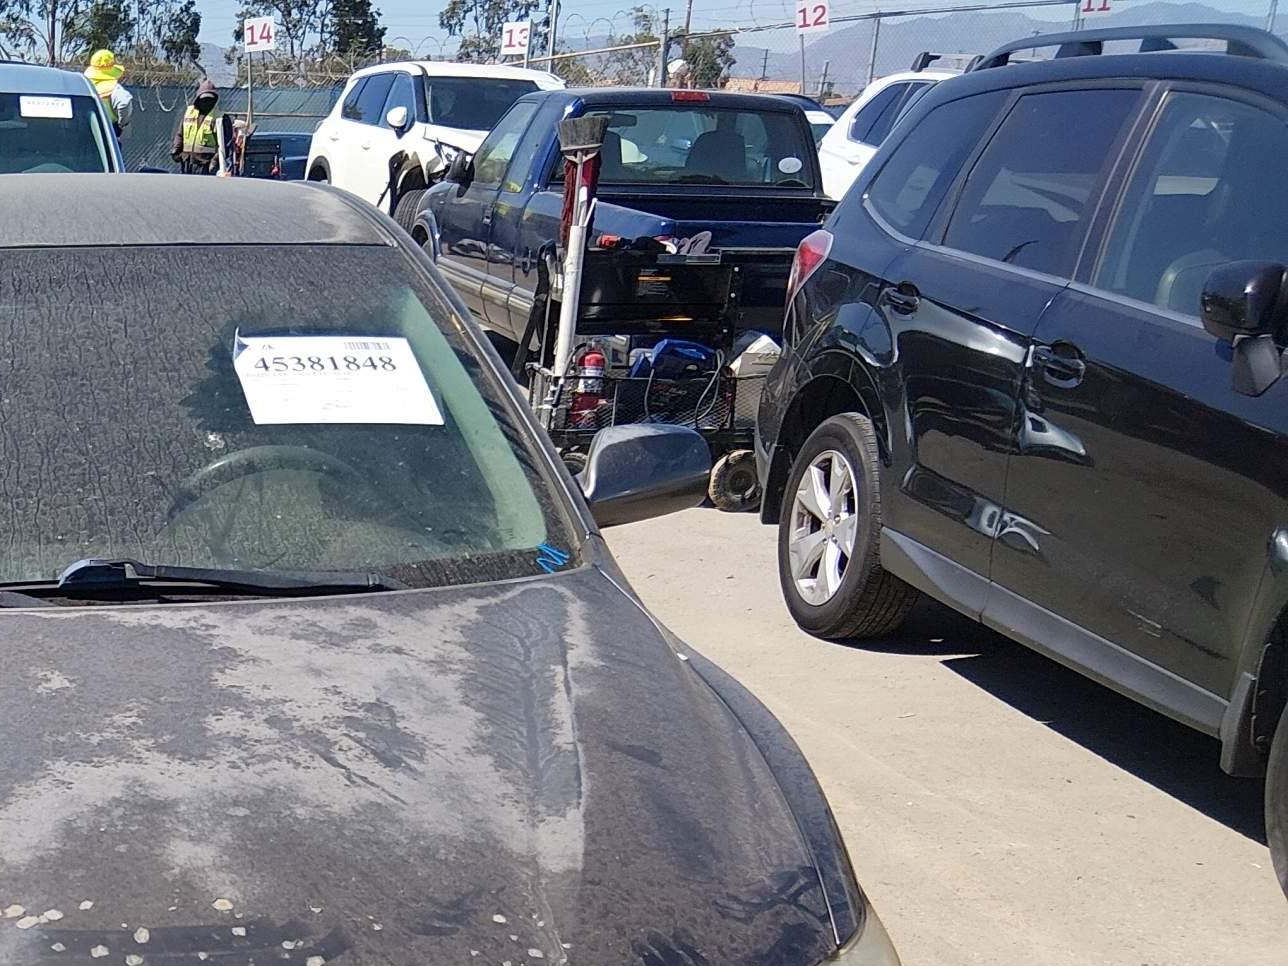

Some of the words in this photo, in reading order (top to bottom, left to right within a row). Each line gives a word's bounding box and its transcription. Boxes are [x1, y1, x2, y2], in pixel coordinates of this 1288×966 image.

[798, 4, 827, 28] 12
[246, 23, 272, 46] 14
[503, 27, 529, 48] 13
[254, 355, 398, 372] 45381848
